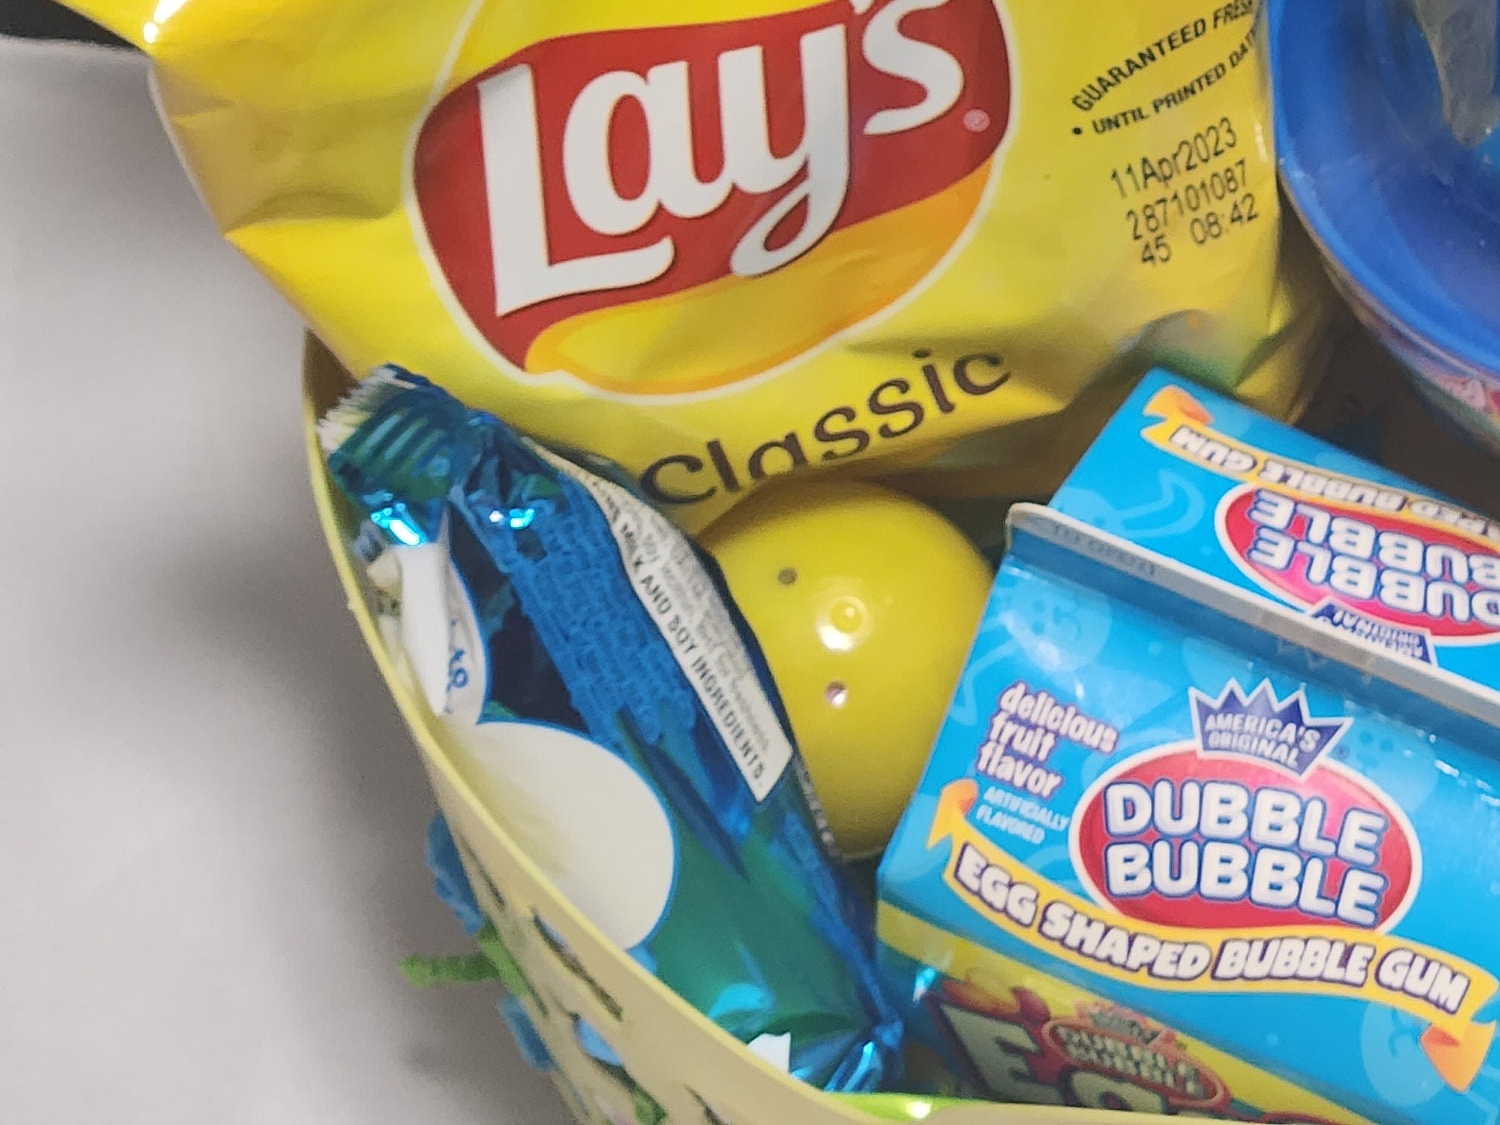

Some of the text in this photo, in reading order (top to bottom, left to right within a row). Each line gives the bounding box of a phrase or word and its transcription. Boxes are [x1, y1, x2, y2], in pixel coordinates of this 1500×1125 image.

[1071, 17, 1207, 113] GUARANTEED
[1091, 106, 1150, 136] UNTIL
[1152, 61, 1228, 117] PRINTED
[1110, 115, 1238, 200] 11Apr2023
[1125, 158, 1249, 242] 287101087
[1140, 235, 1172, 266] 45
[1167, 426, 1258, 474] GUM
[1259, 460, 1411, 514] BUBBLE
[639, 574, 673, 616] AND
[666, 614, 697, 658] SOY
[988, 711, 1057, 763] fruit
[999, 680, 1120, 755] delicious
[1204, 712, 1322, 754] AMERICA'S
[1207, 729, 1301, 770] ORIGINAL
[975, 739, 1064, 800] flavor
[975, 804, 1046, 846] FLAVORED
[983, 786, 1070, 832] ARTIFICIALLY
[1103, 777, 1390, 869] DUBBLE
[1103, 839, 1390, 929] BUBBLE
[953, 841, 1473, 1017] EGG SHAPED BUBBLE GUM
